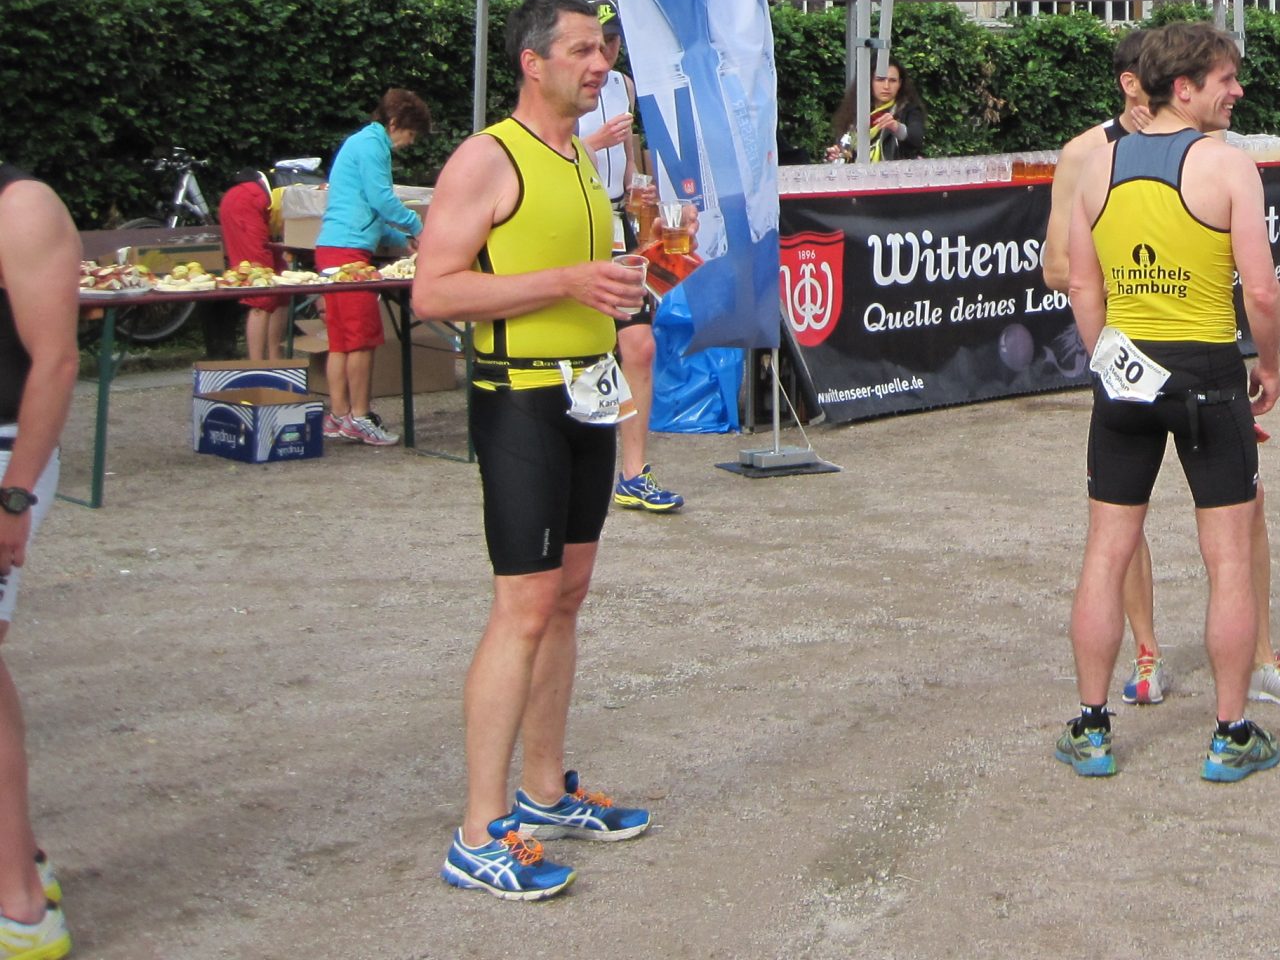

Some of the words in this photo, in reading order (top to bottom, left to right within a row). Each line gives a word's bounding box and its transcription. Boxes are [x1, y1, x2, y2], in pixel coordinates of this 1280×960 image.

[798, 250, 816, 261] 1896
[867, 229, 1047, 287] Wittens
[1111, 265, 1125, 280] tri
[1128, 263, 1192, 281] michels
[1116, 280, 1188, 299] hamburg
[863, 300, 943, 332] Quelle
[949, 293, 1016, 323] deines
[1024, 287, 1072, 314] Leb
[1114, 346, 1145, 384] 30
